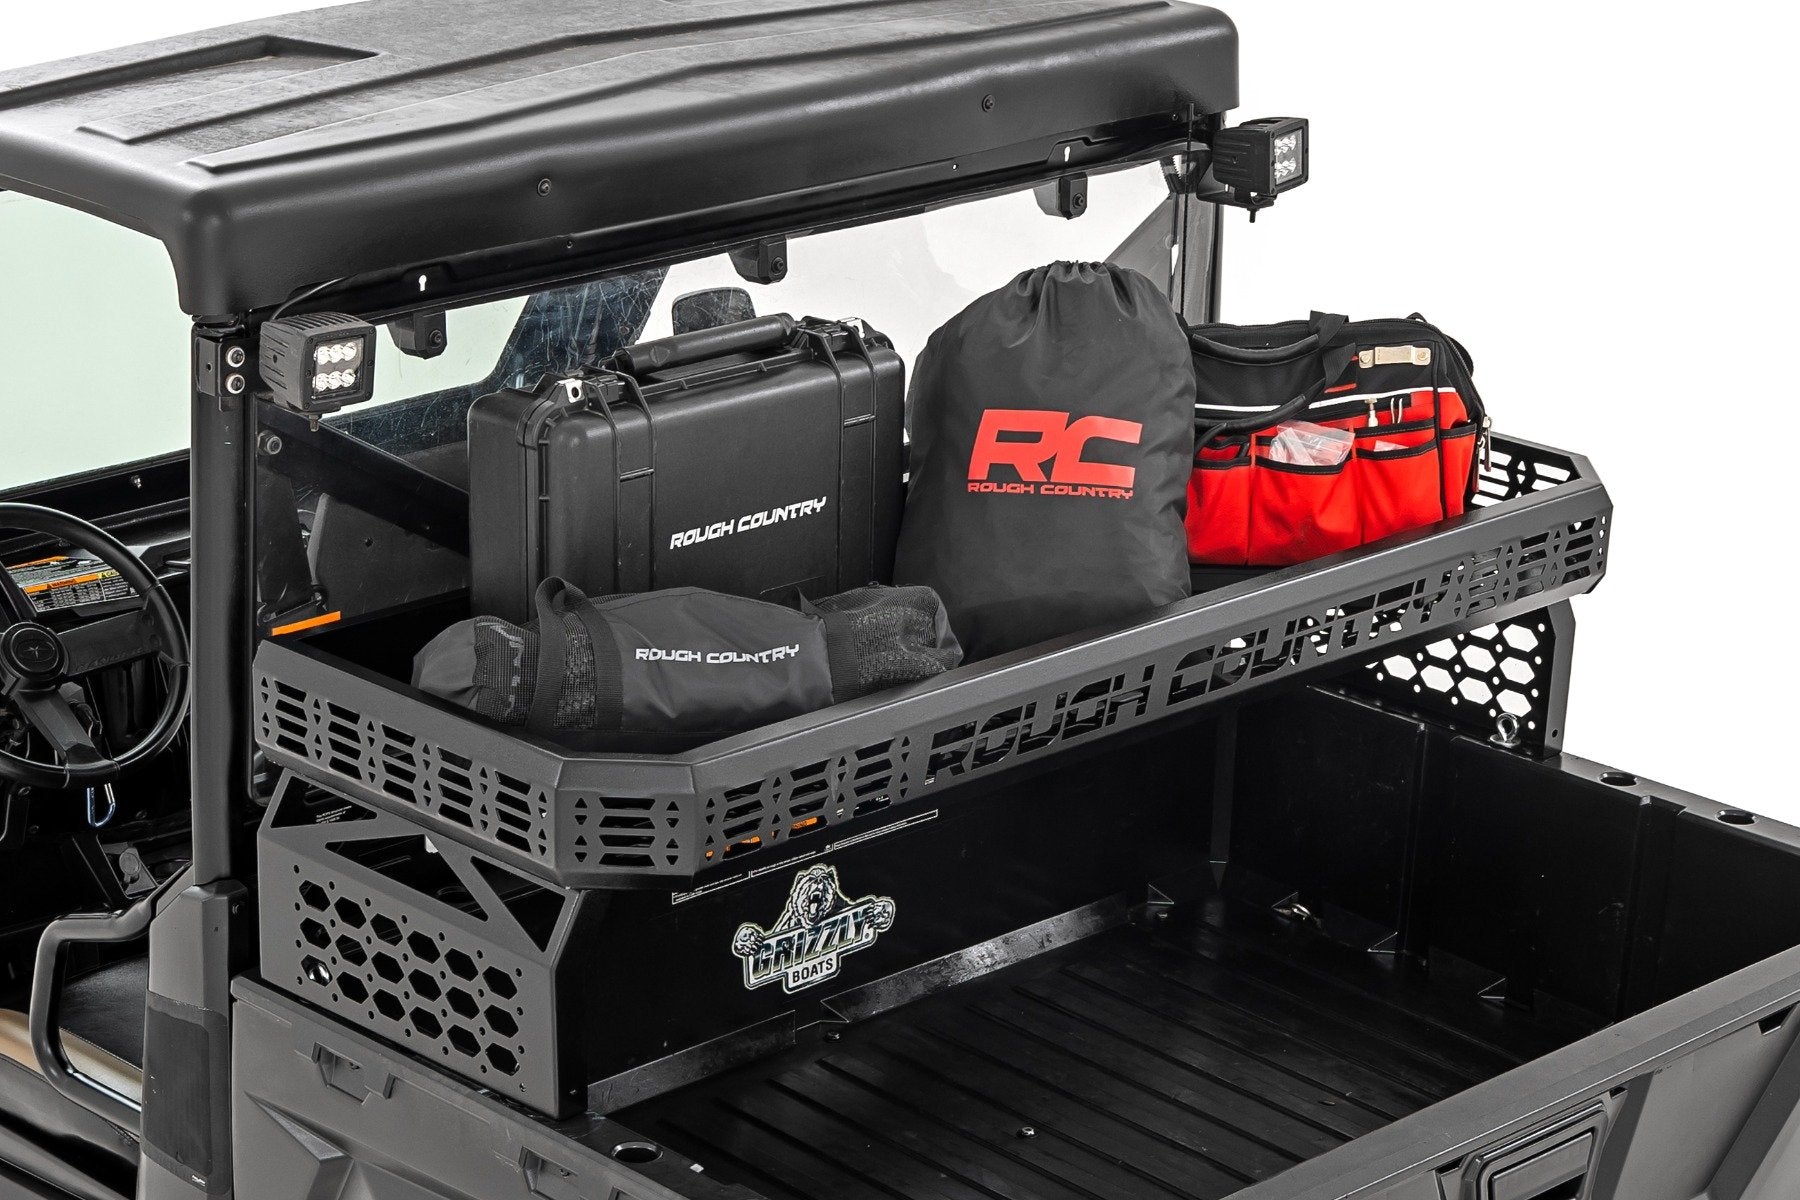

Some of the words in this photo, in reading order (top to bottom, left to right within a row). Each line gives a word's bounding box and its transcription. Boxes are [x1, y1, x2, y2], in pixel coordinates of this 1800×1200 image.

[968, 409, 1143, 488] RC
[967, 482, 1034, 494] ROUGH
[1040, 485, 1134, 499] COUNTRY
[670, 519, 735, 550] ROUGH
[737, 496, 827, 533] COUNTRY
[635, 648, 702, 662] ROUGH
[706, 643, 800, 663] COUNTRY
[924, 664, 1156, 785] ROUGH
[1166, 570, 1452, 706] COUNTRY
[752, 905, 869, 980] GRIZZLY
[792, 958, 834, 984] BOATS
